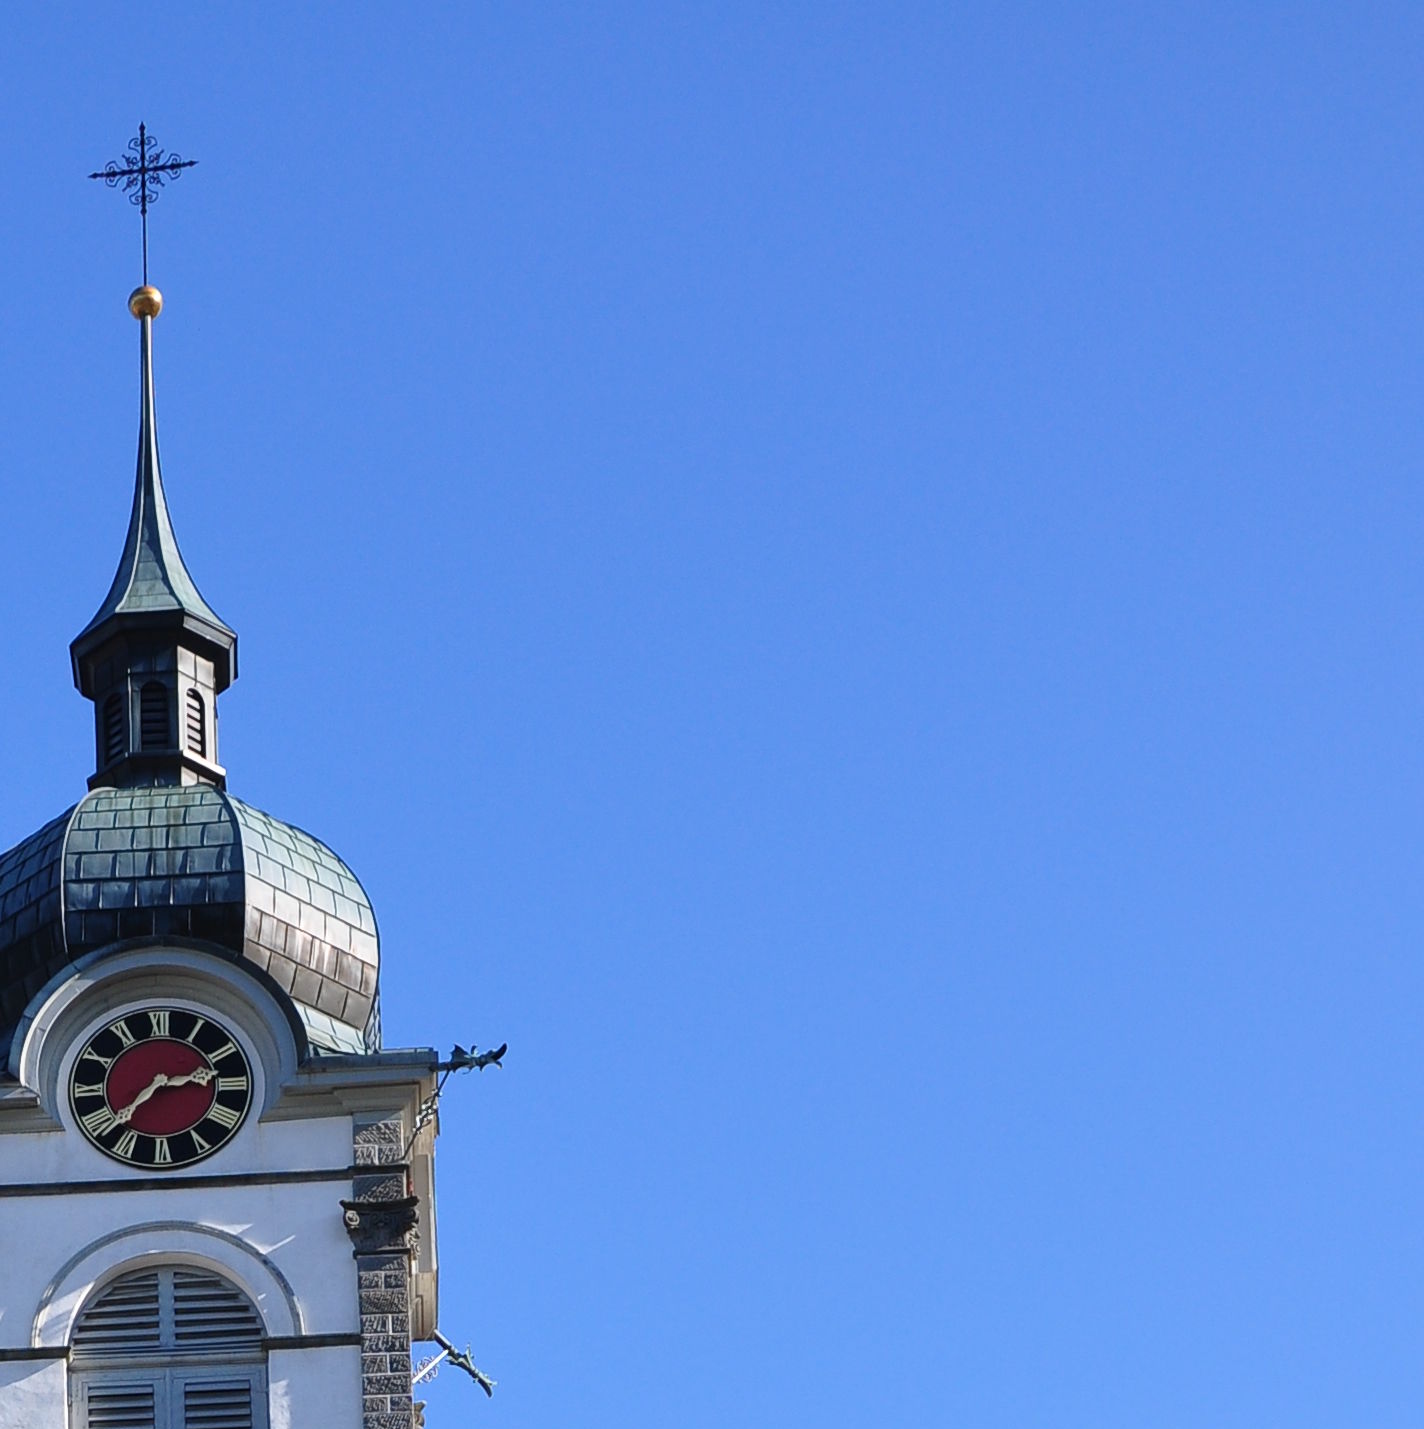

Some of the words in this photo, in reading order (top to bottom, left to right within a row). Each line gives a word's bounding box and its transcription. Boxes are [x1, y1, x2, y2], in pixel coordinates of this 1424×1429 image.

[109, 1019, 137, 1048] XI
[148, 1011, 171, 1037] XII
[185, 1018, 206, 1043] I
[82, 1045, 113, 1068] X
[207, 1041, 238, 1064] II
[74, 1081, 104, 1099] IX
[217, 1075, 247, 1092] III
[80, 1105, 114, 1137] VIII
[207, 1103, 242, 1130] IIII
[110, 1129, 138, 1159] VII
[153, 1136, 173, 1164] VI
[190, 1129, 212, 1154] V
